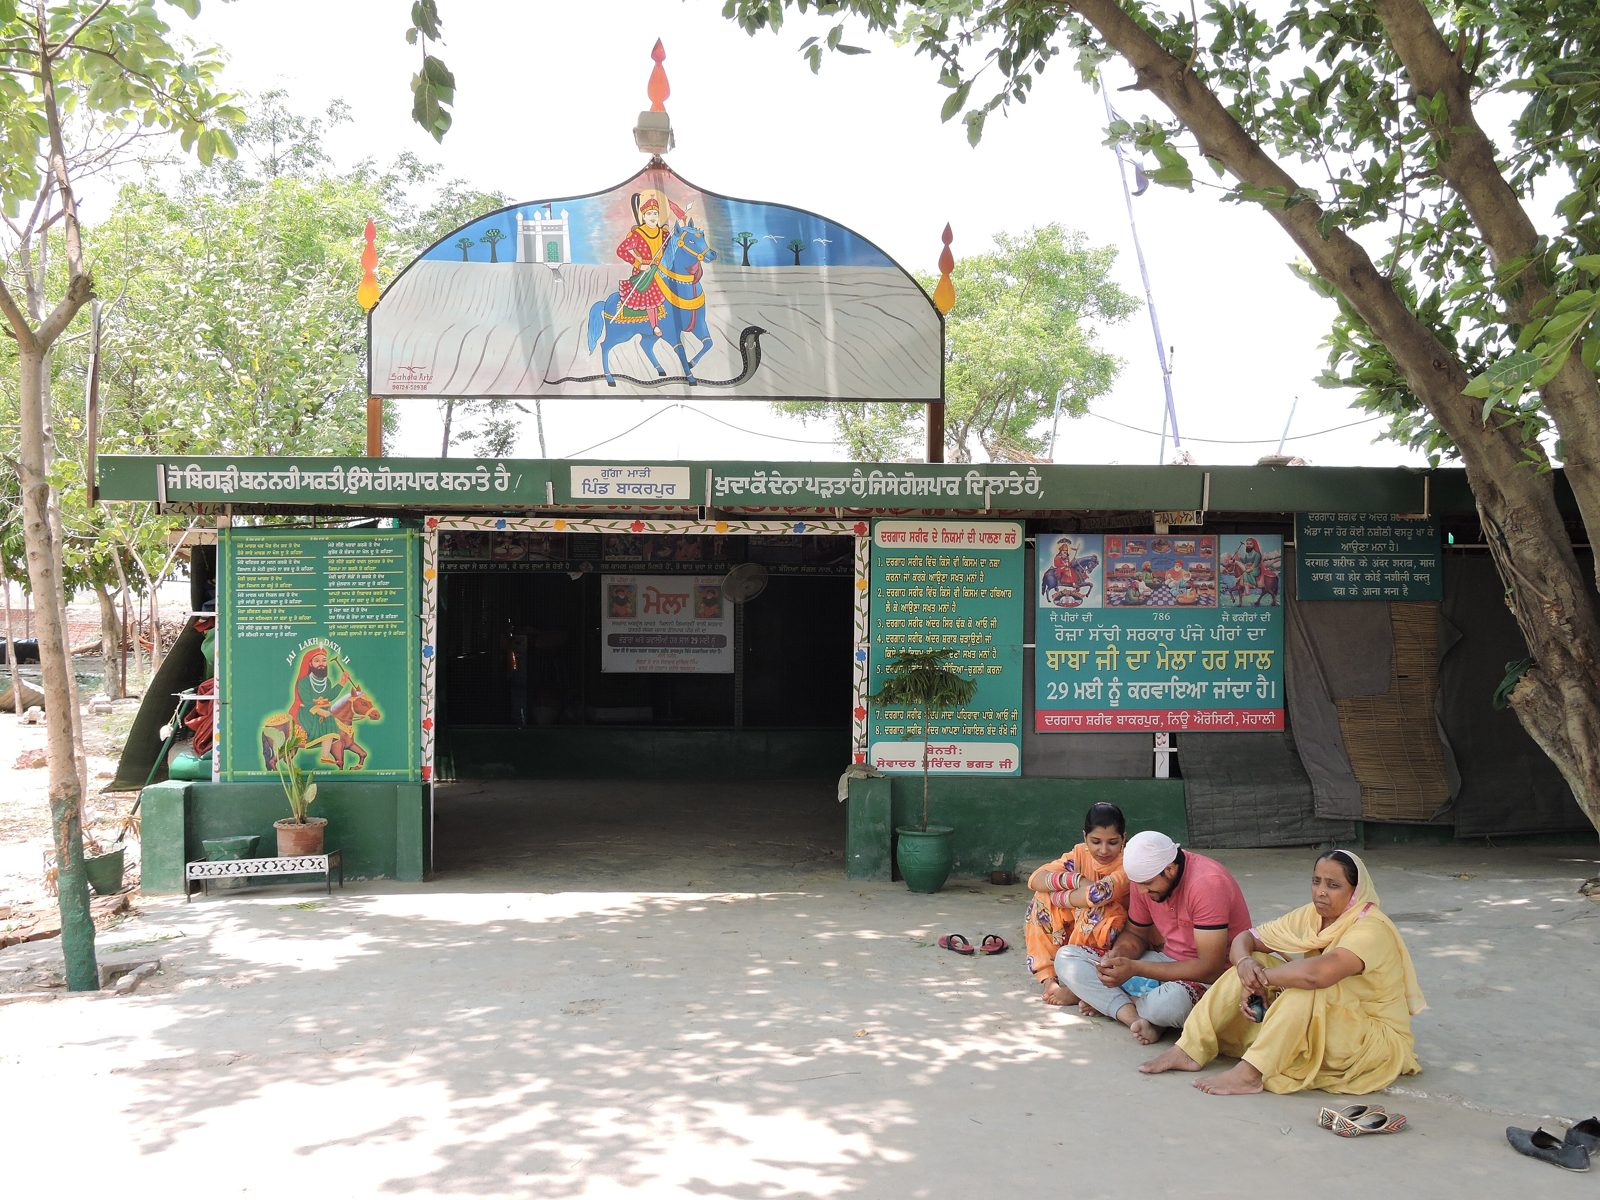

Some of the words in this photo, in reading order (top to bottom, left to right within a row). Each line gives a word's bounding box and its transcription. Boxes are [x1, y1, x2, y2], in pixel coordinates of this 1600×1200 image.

[168, 464, 183, 489] ਜੋ
[184, 464, 238, 493] ਬਿਗੜੀ
[240, 471, 267, 490] ਬਨ
[269, 465, 300, 490] ਨਹੀ
[628, 467, 651, 478] ਮਾੜੀ
[582, 478, 610, 495] ਪਿੰਡ
[617, 483, 676, 498] ਬਾਕਰਪੁਰ
[881, 531, 906, 543] ਦਰਗਾਹ
[932, 528, 939, 543] ਦੇ
[967, 528, 976, 544] ਦੀ
[1358, 556, 1368, 567] के
[1335, 573, 1345, 582] या
[1348, 584, 1359, 596] के
[642, 586, 689, 614] ਮੇਲਾ
[1060, 611, 1079, 622] ਪੀਰਾਂ
[1082, 611, 1093, 622] ਦੀ
[1152, 612, 1171, 622] 786
[1260, 611, 1272, 622] ਦੀ
[1088, 624, 1121, 641] ਸੱਚੀ
[1126, 628, 1176, 641] ਸਰਕਾਰ
[1180, 624, 1205, 641] ਪੰਜੇ
[1210, 624, 1242, 641] ਪੀਰਾਂ
[1247, 628, 1266, 641] ਦਾ
[286, 650, 297, 666] JAI
[298, 637, 319, 651] LAKH
[324, 638, 342, 655] DATA
[342, 655, 351, 664] JI
[1046, 650, 1089, 671] ਬਾਬਾ
[1095, 643, 1119, 671] ਜੀ
[1125, 650, 1150, 671] ਦਾ
[1156, 643, 1196, 671] ਮੇਲਾ
[1202, 650, 1229, 671] ਹਰ
[1234, 650, 1275, 671] ਸਾਲ
[1047, 682, 1069, 700] 29
[1074, 676, 1104, 700] ਮਈ
[1108, 676, 1123, 707] ਨੂੰ
[1127, 676, 1208, 700] ਕਰਵਾਇਆ
[1212, 677, 1252, 699] ਜਾਂਦਾ
[1044, 715, 1083, 726] ਦਰਗਾਹ
[1167, 711, 1190, 729] ਨਿਊ
[1242, 711, 1276, 725] ਮੋਹਾਲੀ
[966, 760, 994, 769] ਭਗਤ
[999, 758, 1013, 769] ਜੀ
